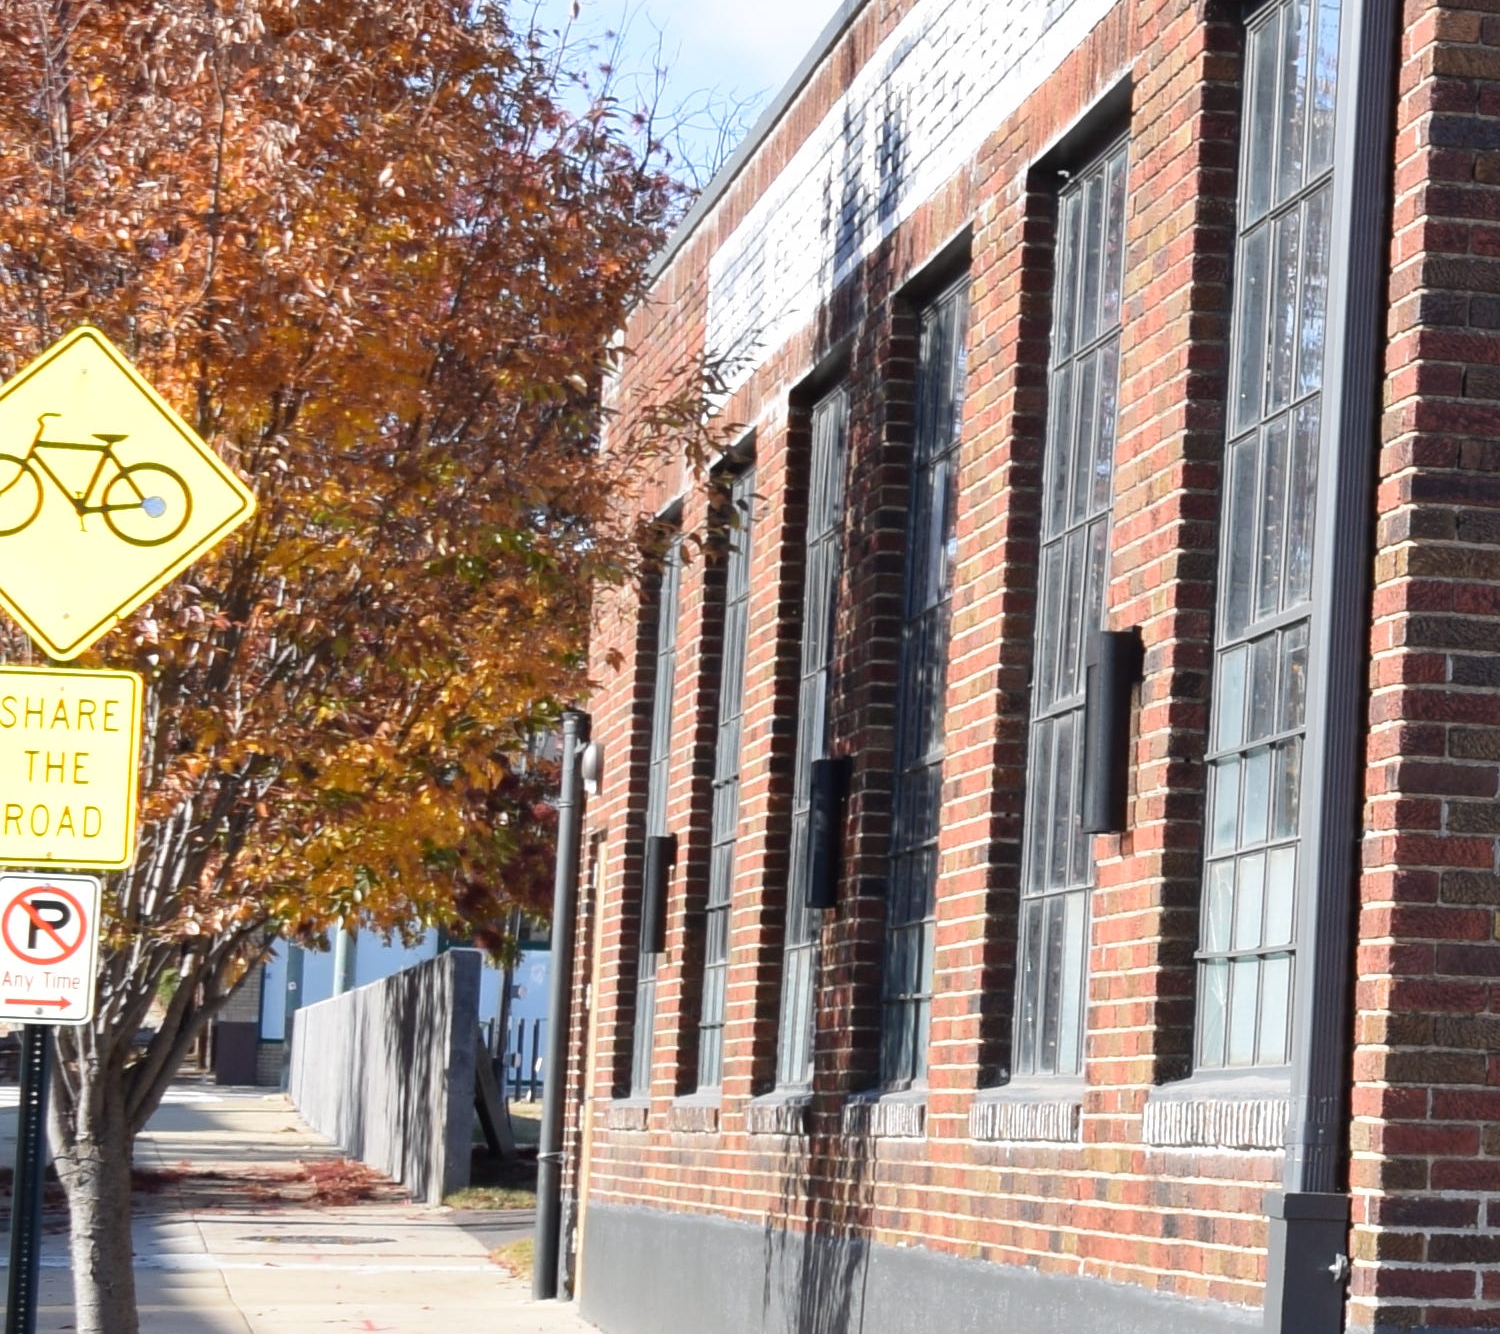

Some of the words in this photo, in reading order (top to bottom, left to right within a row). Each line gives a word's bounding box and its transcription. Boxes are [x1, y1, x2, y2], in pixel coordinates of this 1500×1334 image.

[0, 696, 119, 732] SHARE
[25, 750, 89, 784] THE
[4, 803, 102, 838] ROAD
[2, 971, 35, 992] Any
[43, 972, 82, 991] Time
